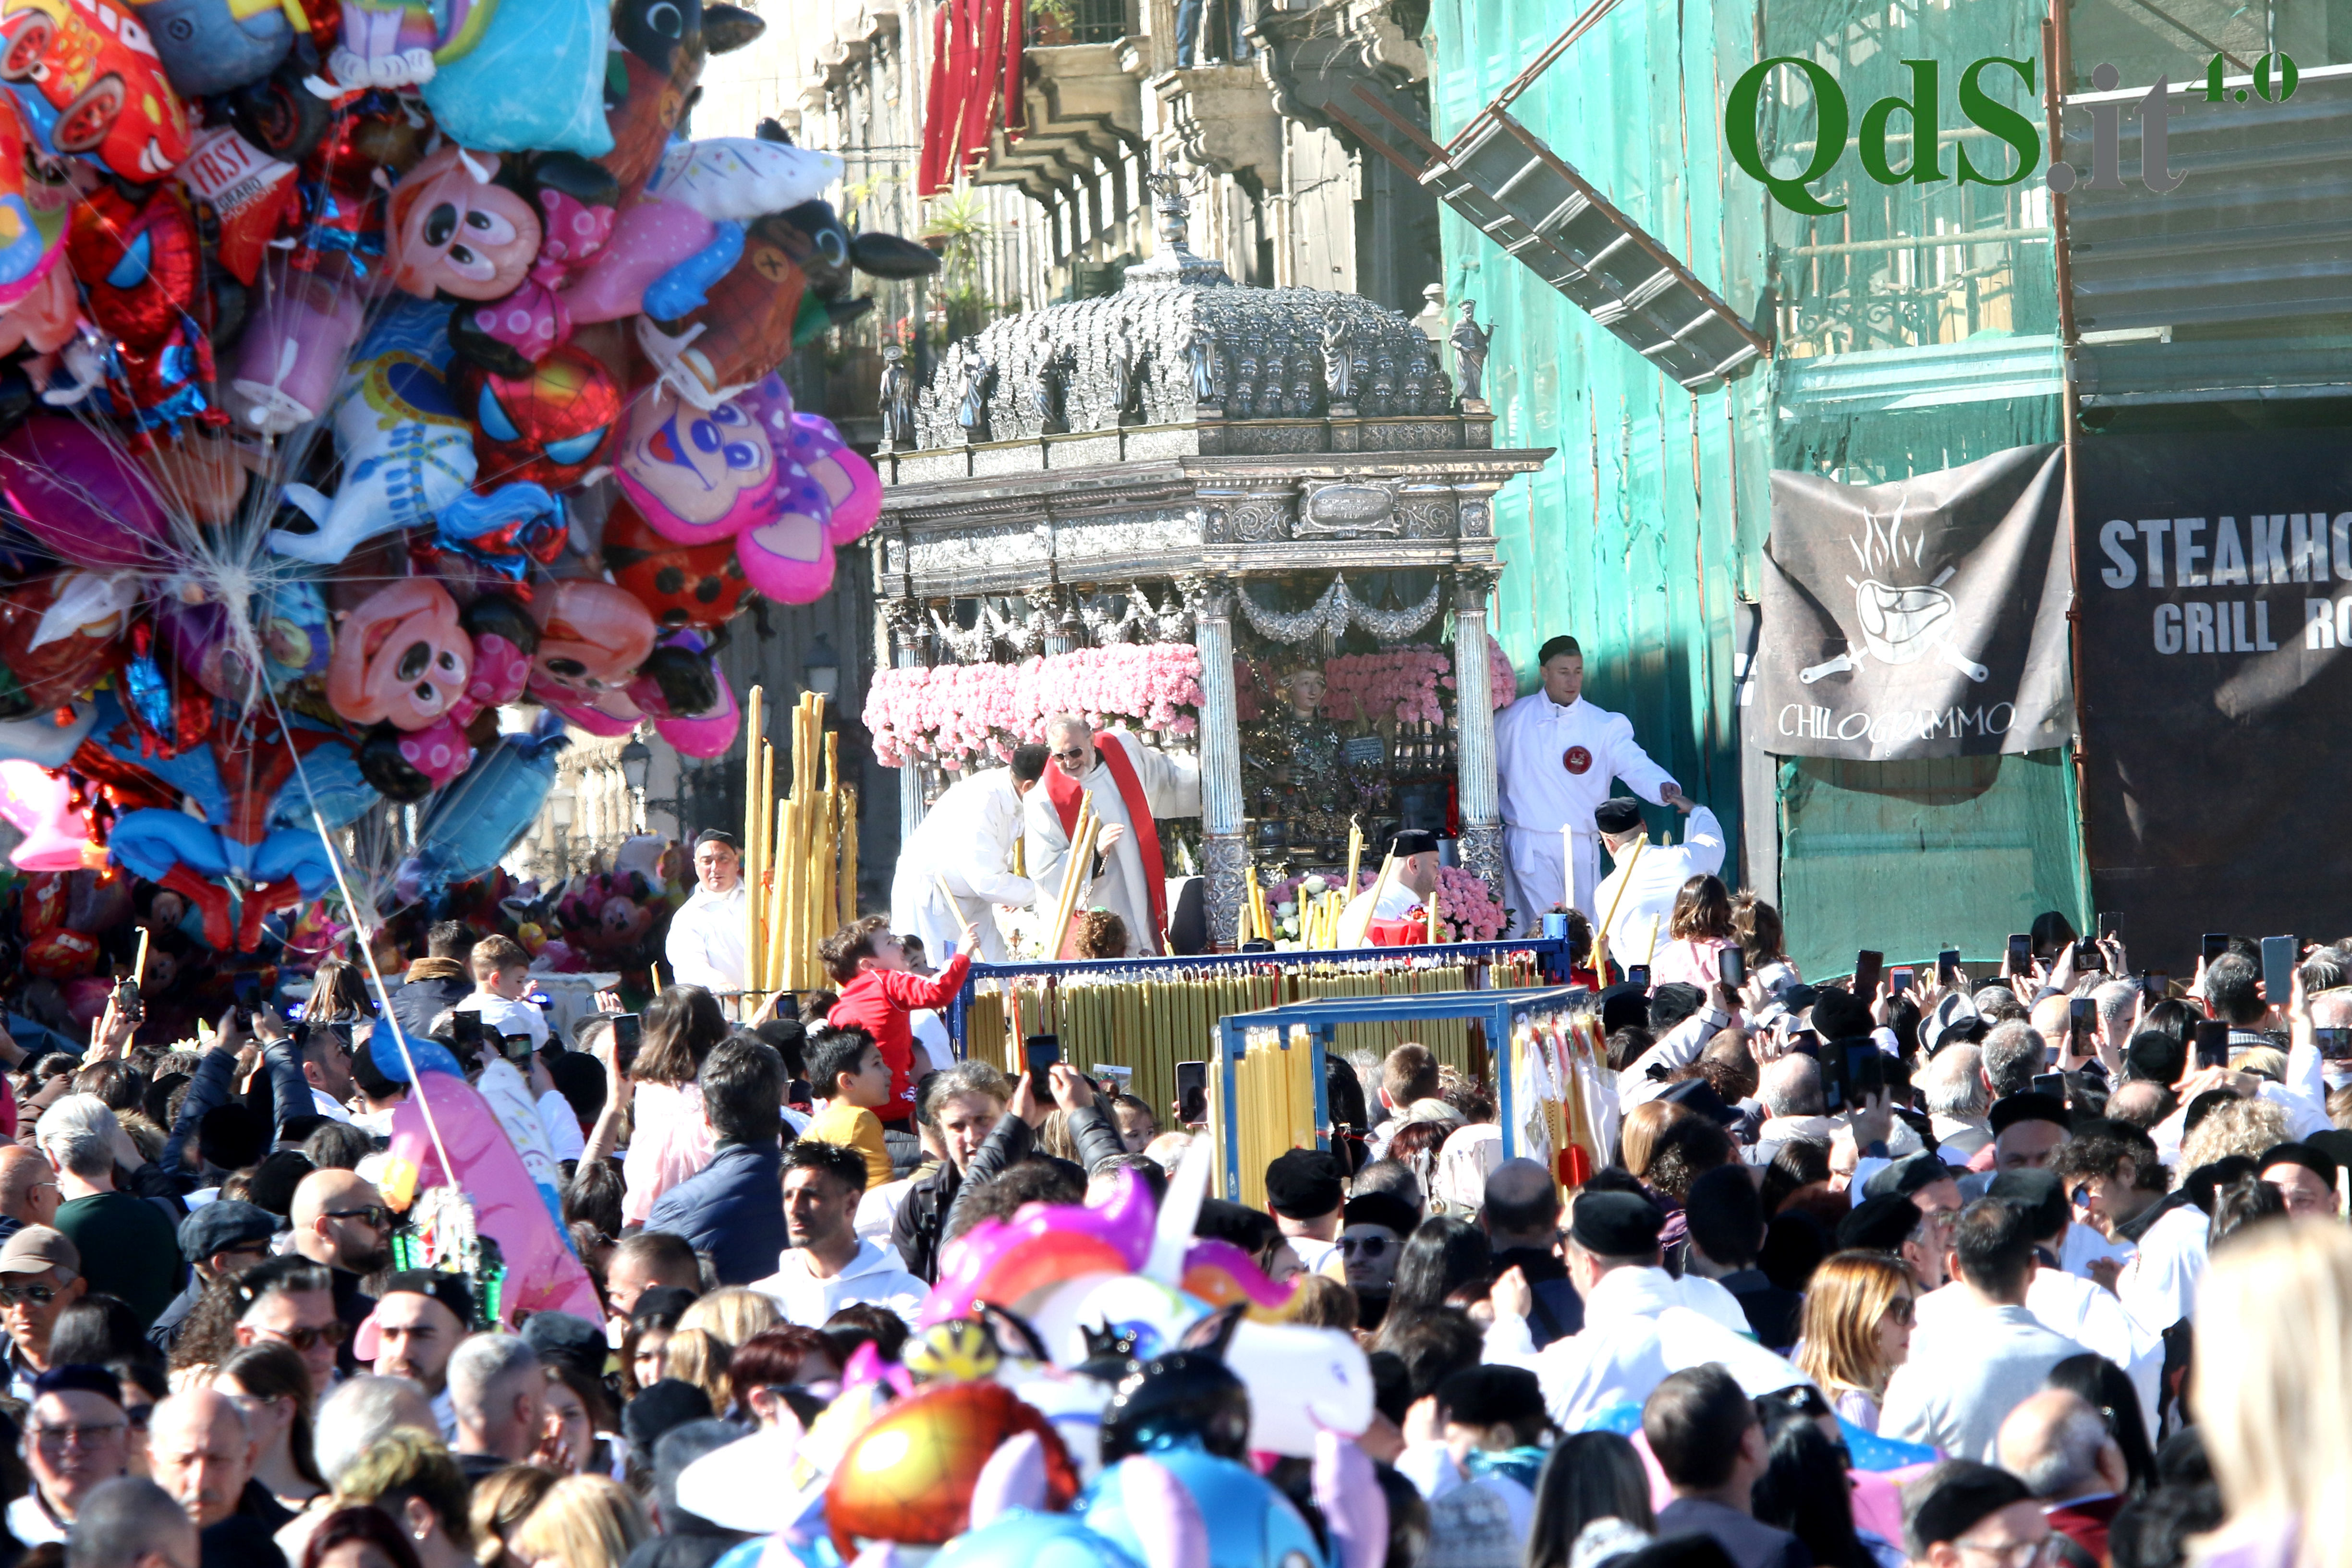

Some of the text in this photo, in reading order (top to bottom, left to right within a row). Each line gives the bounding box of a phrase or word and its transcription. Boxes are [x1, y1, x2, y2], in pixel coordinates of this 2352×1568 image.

[190, 137, 251, 194] FAST
[2153, 601, 2278, 655] GRILL
[1778, 702, 2016, 743] CHILOGRAMMO
